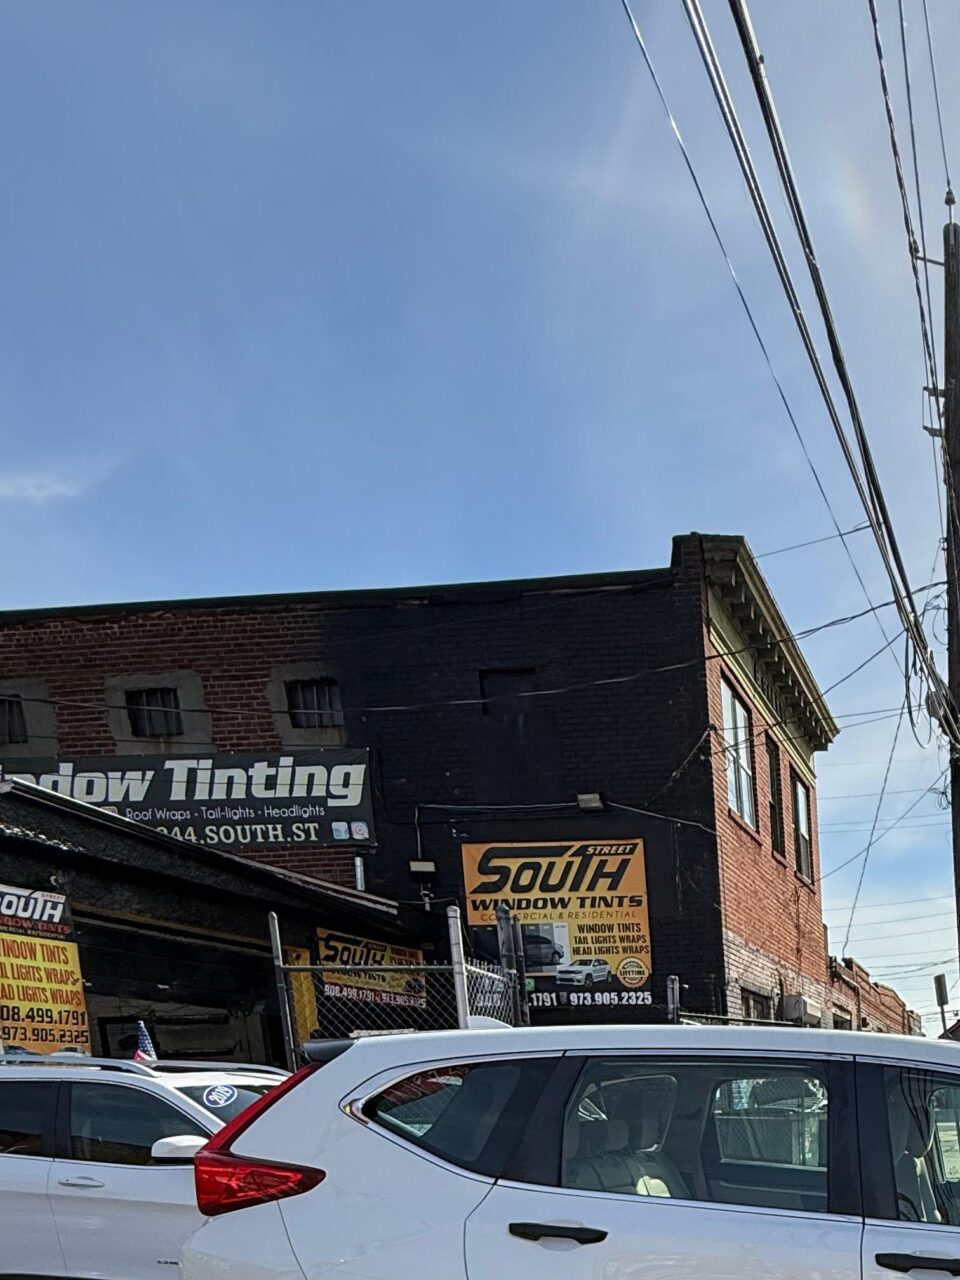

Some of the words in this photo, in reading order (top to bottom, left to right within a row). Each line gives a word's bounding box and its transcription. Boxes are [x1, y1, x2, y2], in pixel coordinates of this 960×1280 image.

[0, 763, 155, 802] dow
[164, 757, 366, 806] Tinting
[126, 807, 152, 821] Roof
[154, 807, 191, 821] Wraps
[201, 805, 255, 820] Tail-lights
[264, 804, 325, 821] Headlights
[586, 844, 633, 855] STREET
[469, 844, 636, 894] SOUTH
[470, 897, 571, 911] WINDOW
[576, 895, 643, 909] TINTS
[558, 912, 564, 920] &
[567, 910, 637, 920] RESIDENTIAL
[577, 923, 614, 934] WINDOW
[617, 922, 641, 933] TINTS
[574, 936, 589, 945] TAIL
[591, 935, 617, 945] LIGHTS
[618, 934, 647, 944] WRAPS
[0, 938, 37, 961] INDOW
[39, 943, 69, 966] TINTS
[572, 946, 593, 956] HEAD
[594, 946, 620, 955] LIGHTS
[621, 945, 650, 954] WRAPS
[10, 962, 43, 983] LIGHTS
[43, 966, 77, 987] WRAPS
[16, 984, 49, 1004] LIGHTS
[49, 987, 82, 1007] WRAPS
[570, 991, 652, 1006] 973.905.2325
[2, 1026, 89, 1043] 973.905.2325
[208, 1085, 233, 1105] 2019
